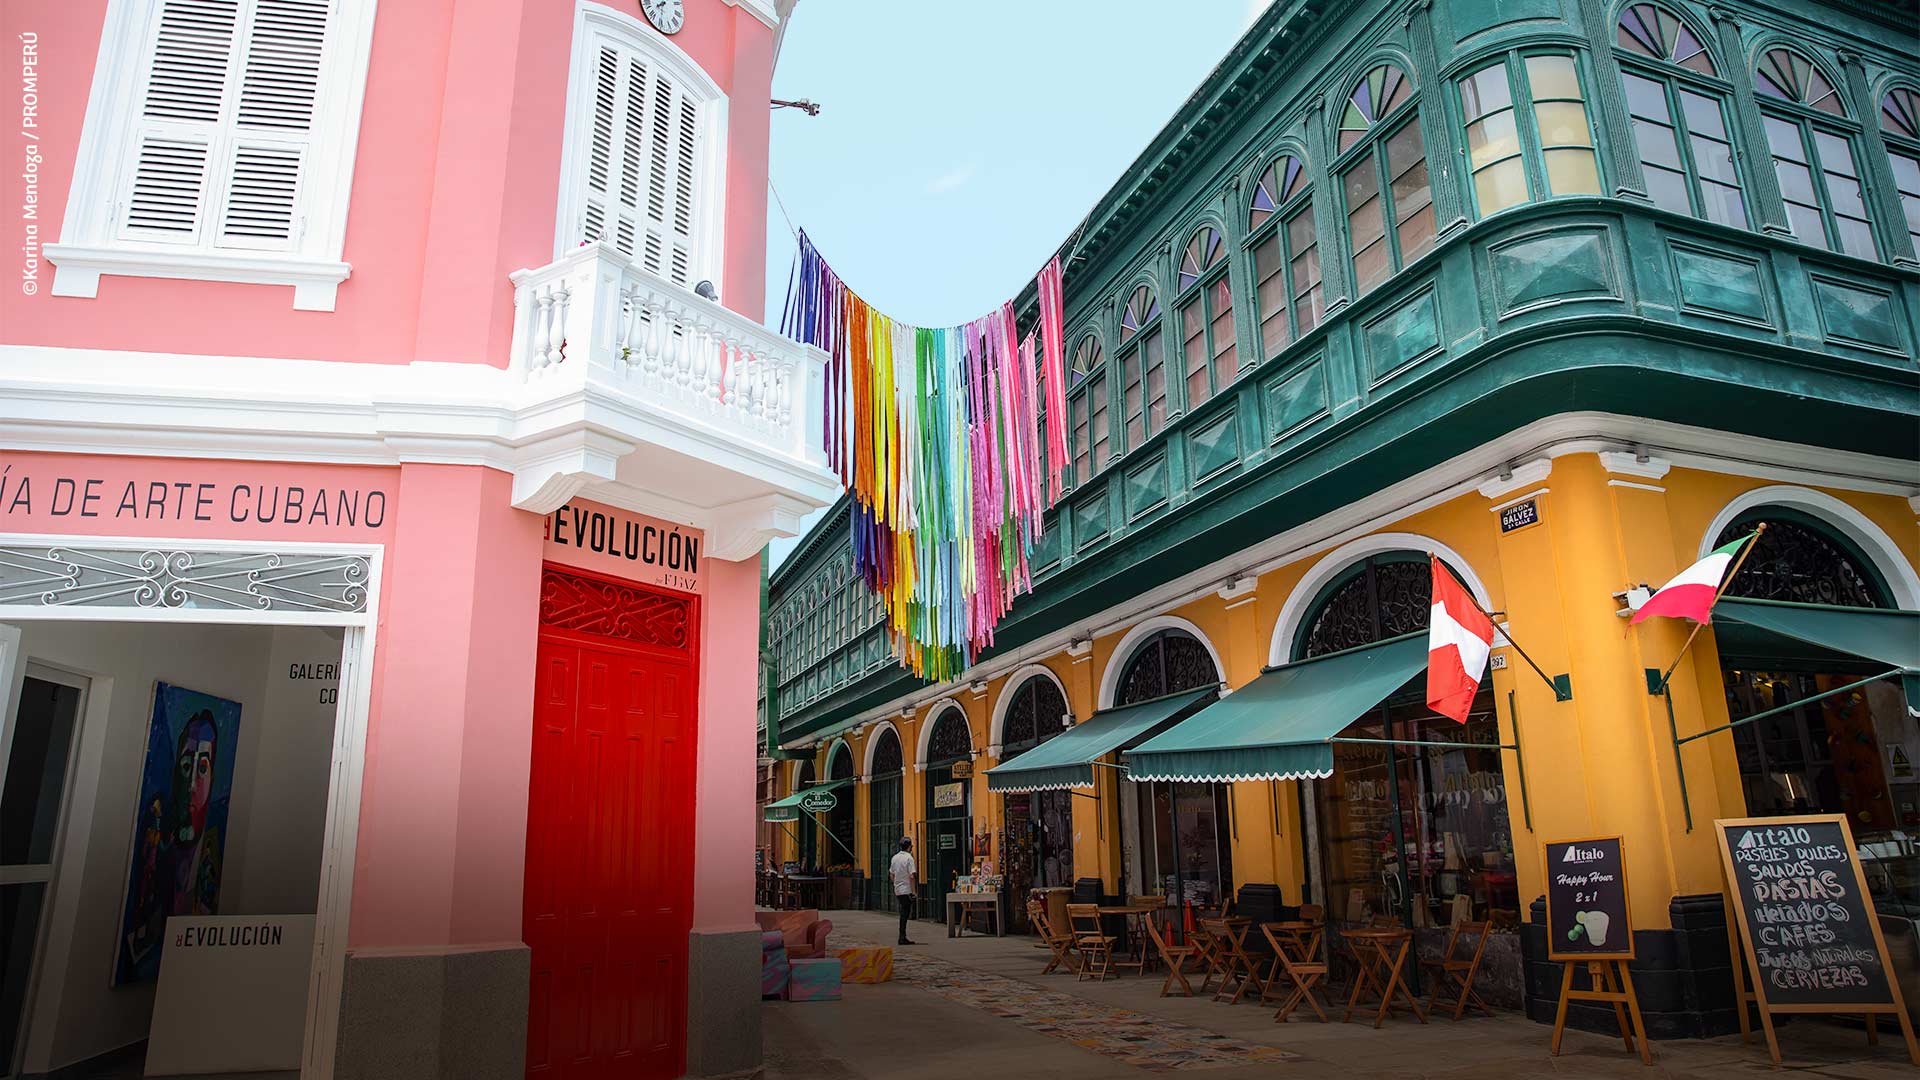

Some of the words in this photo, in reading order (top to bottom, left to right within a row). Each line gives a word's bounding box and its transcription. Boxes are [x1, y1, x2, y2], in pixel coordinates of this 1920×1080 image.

[50, 478, 104, 517] DE
[115, 481, 216, 521] ARTE
[230, 485, 385, 528] CUBANO
[289, 661, 340, 680] GALERÍ
[804, 798, 832, 807] Comedor
[1556, 873, 1588, 886] Happy
[1588, 871, 1614, 883] Hour
[1748, 860, 1816, 881] SALADOS
[1752, 870, 1846, 902] PASTAS
[1575, 892, 1583, 902] 2
[1592, 891, 1598, 901] 1
[1771, 966, 1868, 990] CERVEZAS
